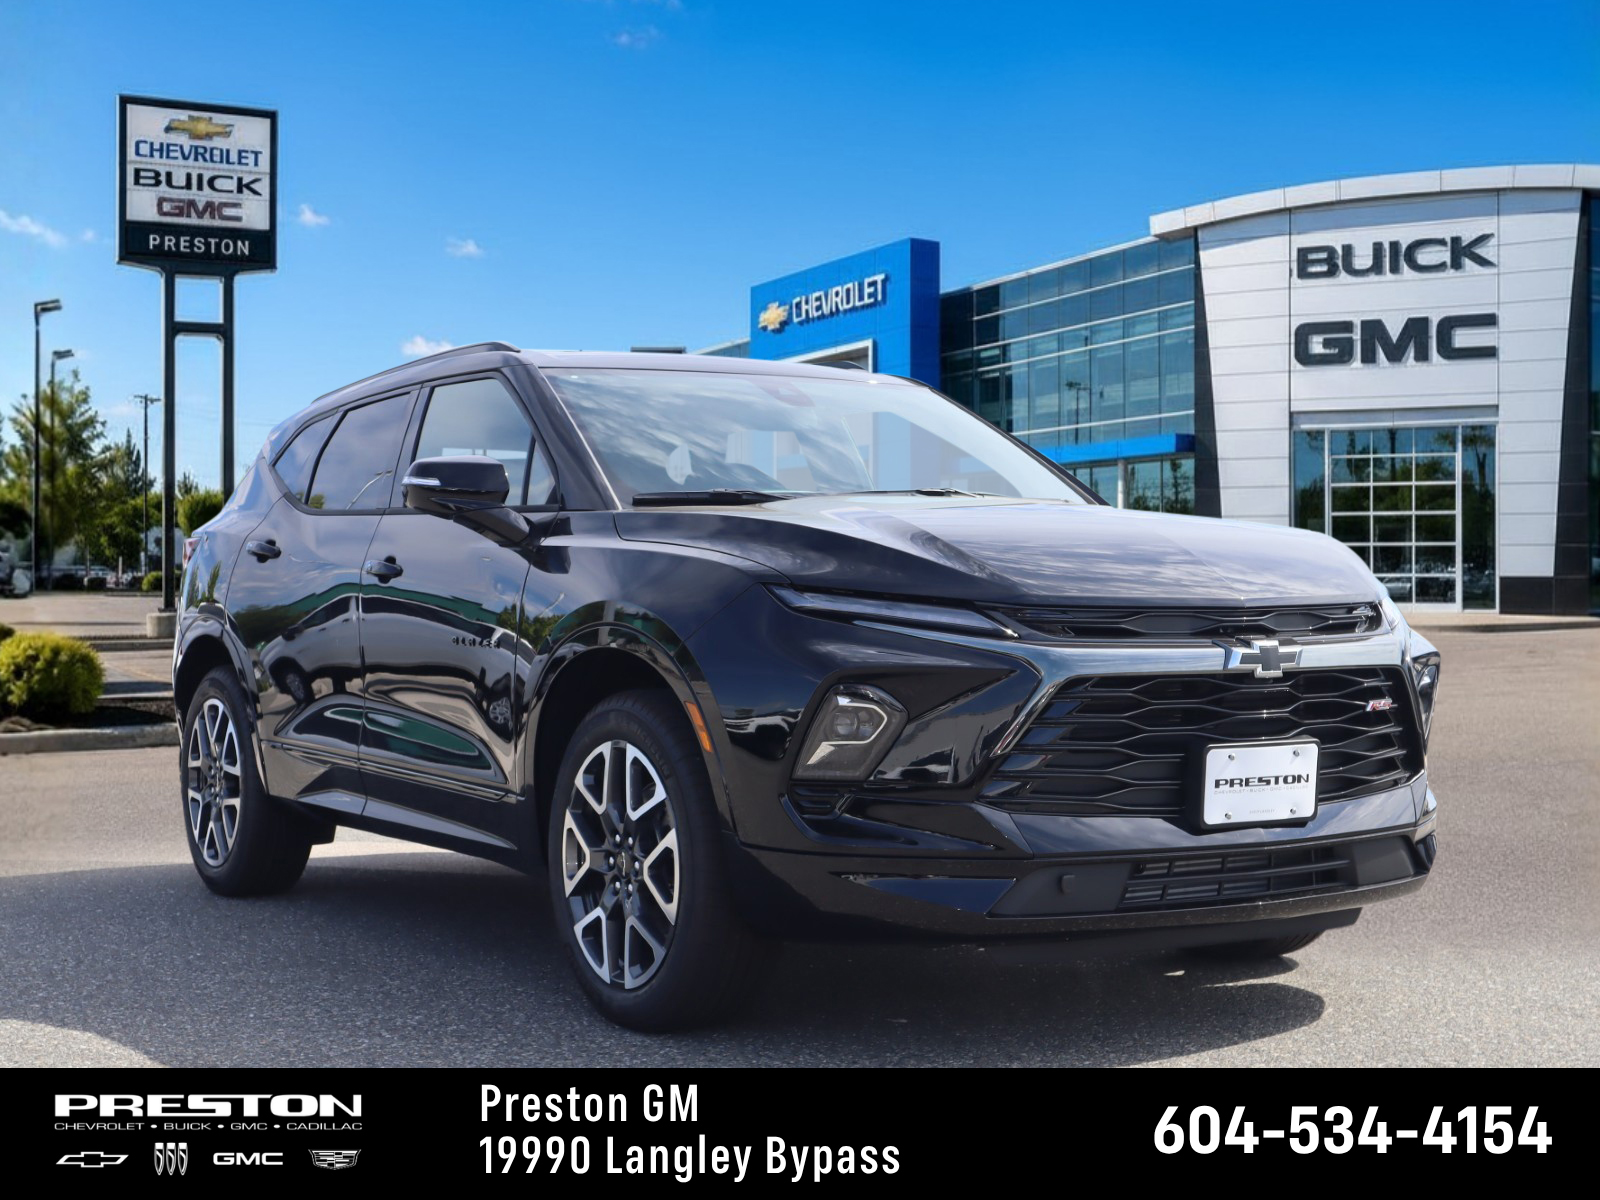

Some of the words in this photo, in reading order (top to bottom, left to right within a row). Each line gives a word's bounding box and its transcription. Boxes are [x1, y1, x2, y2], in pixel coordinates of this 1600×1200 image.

[134, 139, 263, 167] CHEVROLET
[133, 167, 262, 197] BUICK
[156, 196, 243, 222] GMC
[148, 233, 250, 256] PRESTON
[1297, 233, 1497, 280] BUICK
[792, 272, 887, 324] CHEVROLET
[1294, 313, 1497, 367] GMC
[1214, 773, 1310, 789] PRESTON
